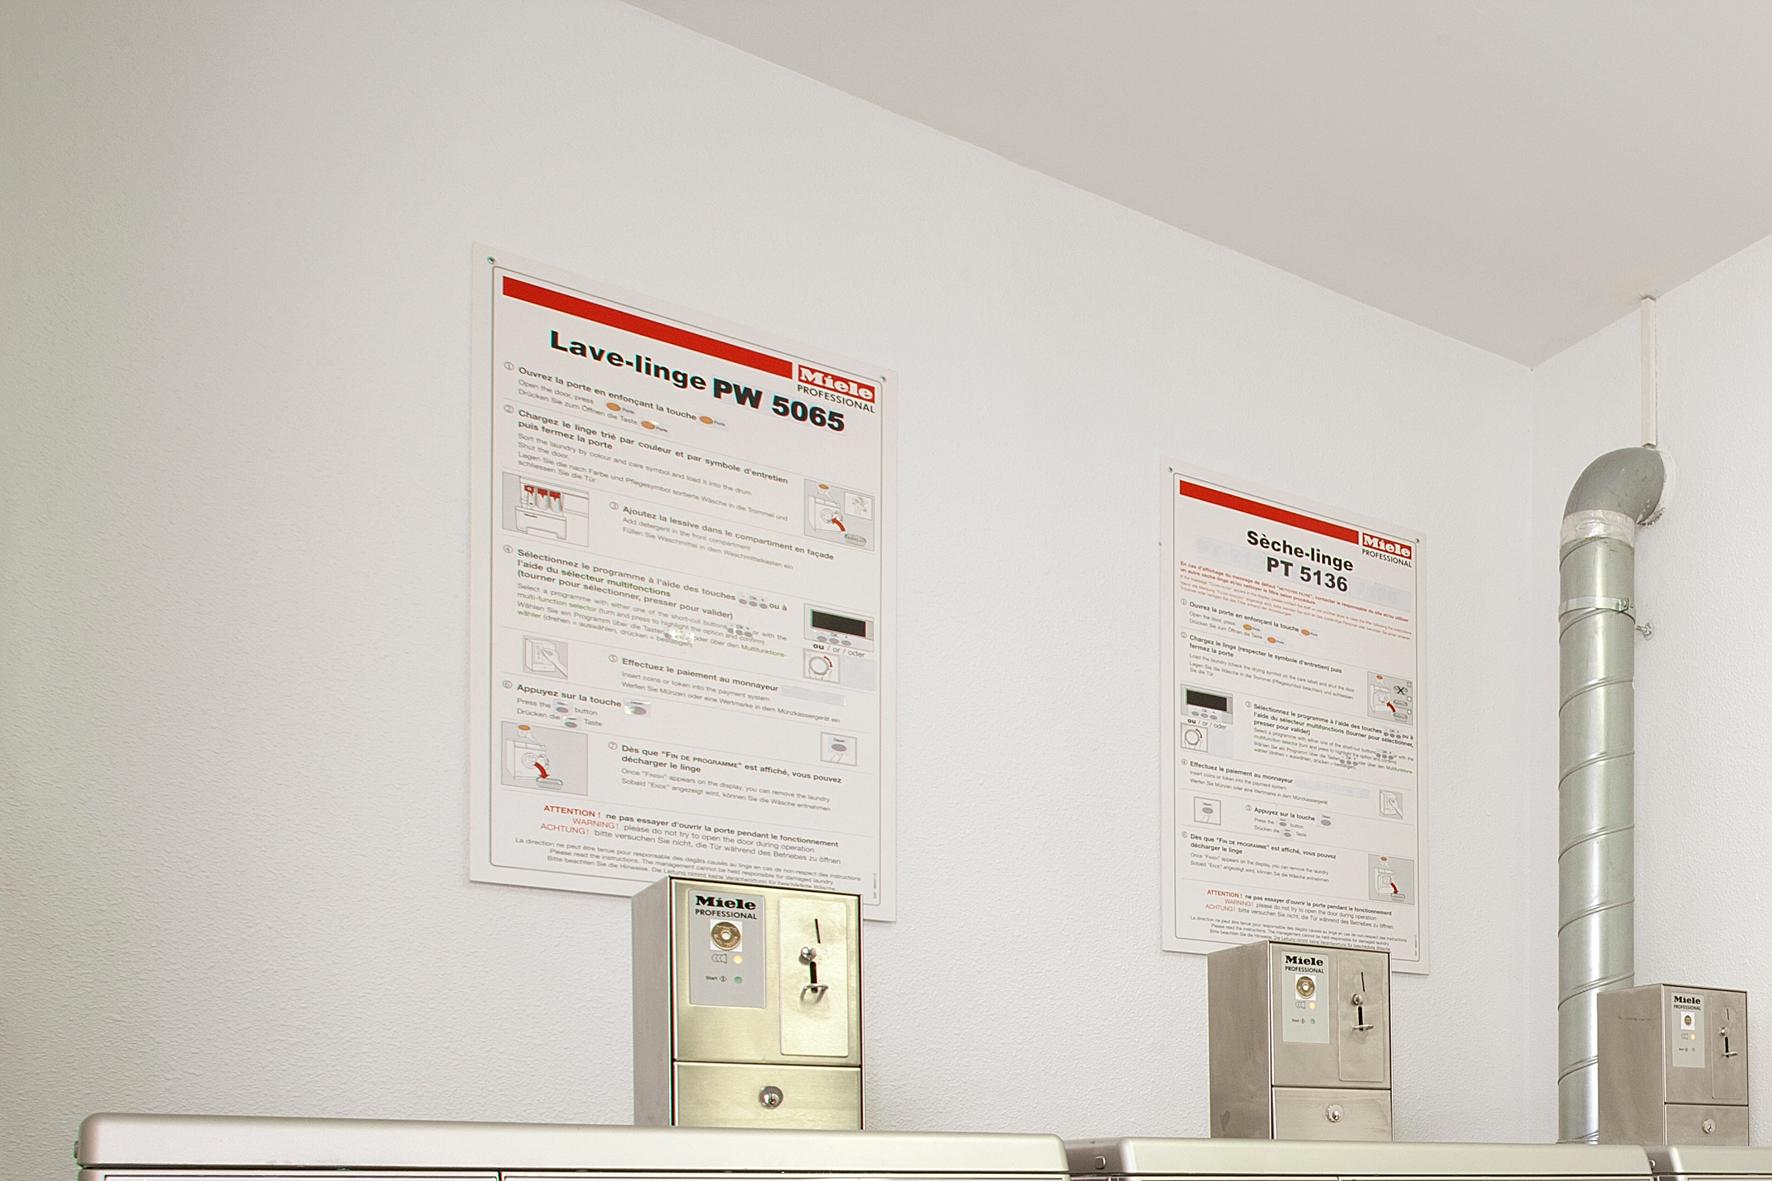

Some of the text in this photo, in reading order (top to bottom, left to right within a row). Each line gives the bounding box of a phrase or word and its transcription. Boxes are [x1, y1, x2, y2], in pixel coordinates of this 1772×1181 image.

[550, 329, 845, 432] Lave-linge PW 5065
[800, 367, 873, 400] Miele
[518, 366, 697, 420] Ouvrez la porte en enfonçant la touche
[797, 384, 876, 414] PROFESSIONAL
[1246, 530, 1353, 571] Sèche-linge
[1364, 535, 1411, 557] Miele
[1362, 548, 1412, 568] PROFESSIONAL
[1266, 556, 1348, 592] PT 5136
[695, 895, 757, 910] Miele
[695, 909, 757, 920] PROFESSIONAL
[1285, 955, 1324, 967] Miele
[1285, 966, 1325, 974] PROFESSIONAL
[1674, 996, 1701, 1005] Miele
